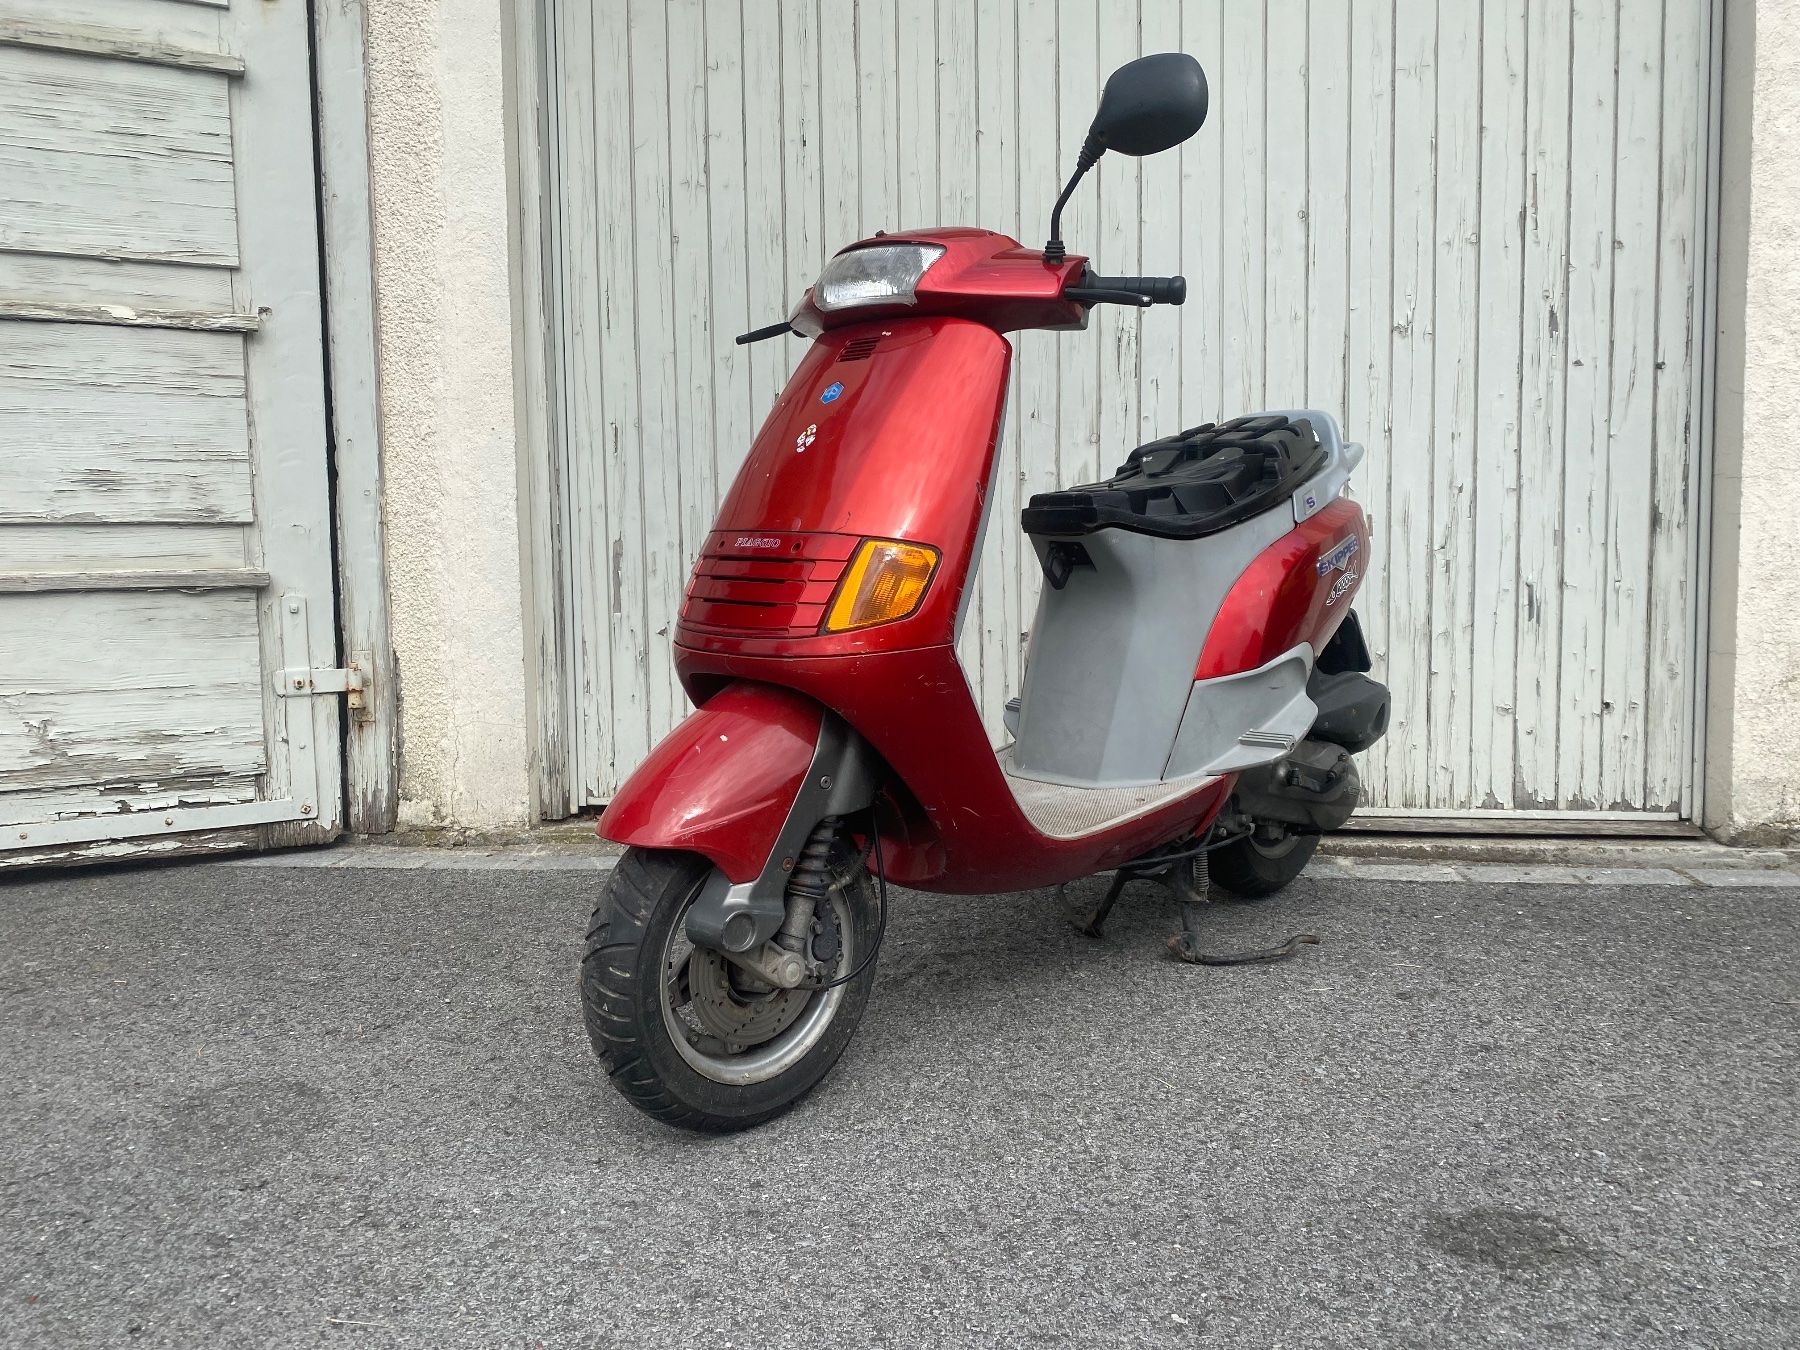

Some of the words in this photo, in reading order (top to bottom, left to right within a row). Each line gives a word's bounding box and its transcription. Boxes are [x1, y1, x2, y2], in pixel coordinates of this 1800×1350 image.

[1305, 496, 1316, 508] S
[734, 537, 781, 548] PIAGGIO
[1319, 539, 1359, 575] SKIPPER
